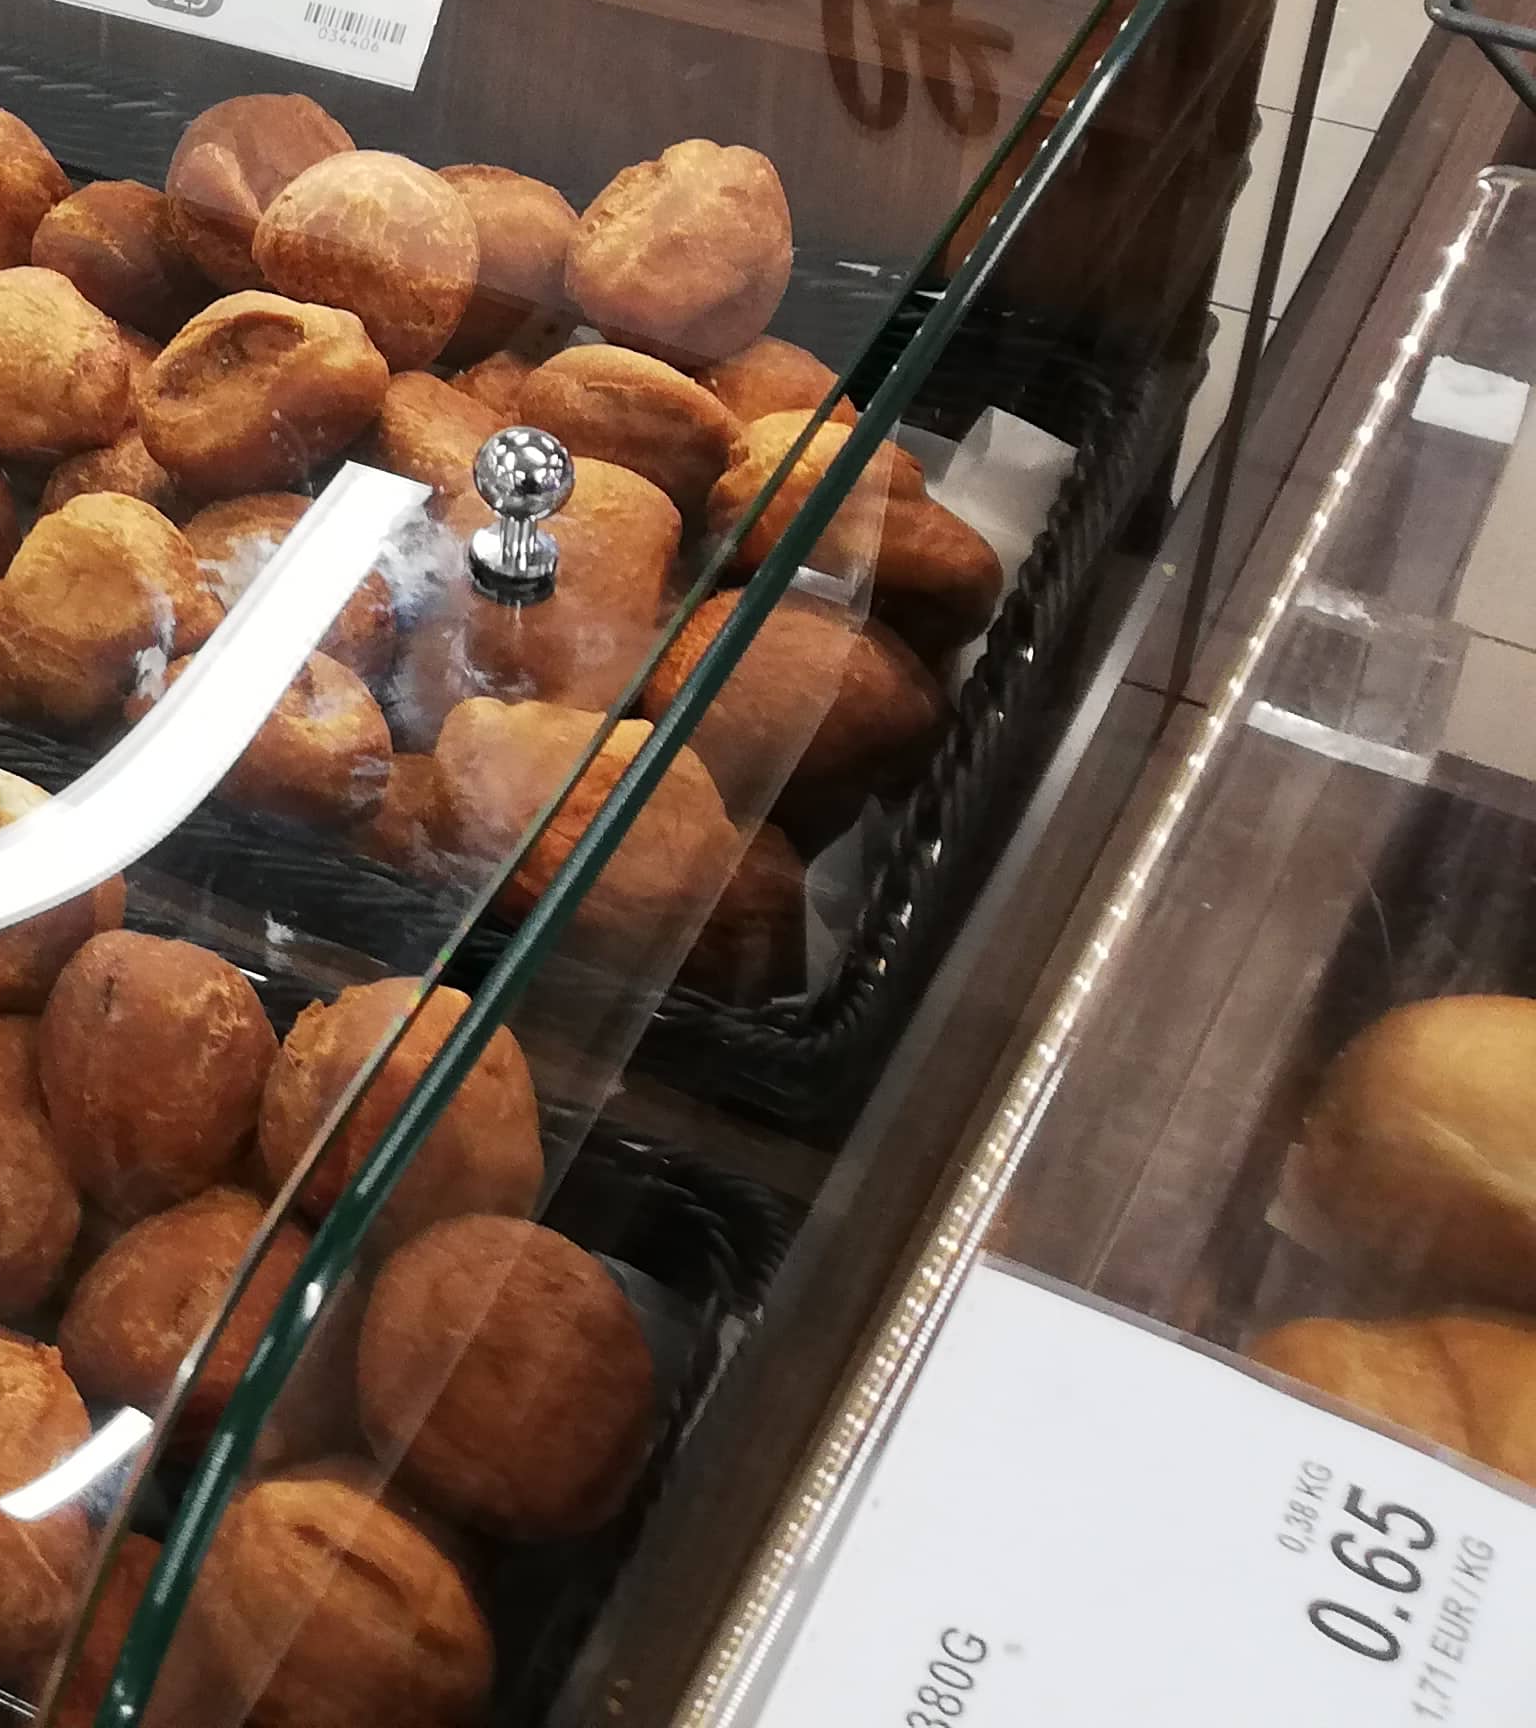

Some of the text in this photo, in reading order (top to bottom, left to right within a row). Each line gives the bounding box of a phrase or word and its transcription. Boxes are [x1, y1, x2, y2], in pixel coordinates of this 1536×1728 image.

[1277, 1459, 1334, 1555] 0,38 KG
[1306, 1482, 1436, 1663] 0.65
[1430, 1596, 1476, 1664] EUR
[1454, 1535, 1495, 1583] KG
